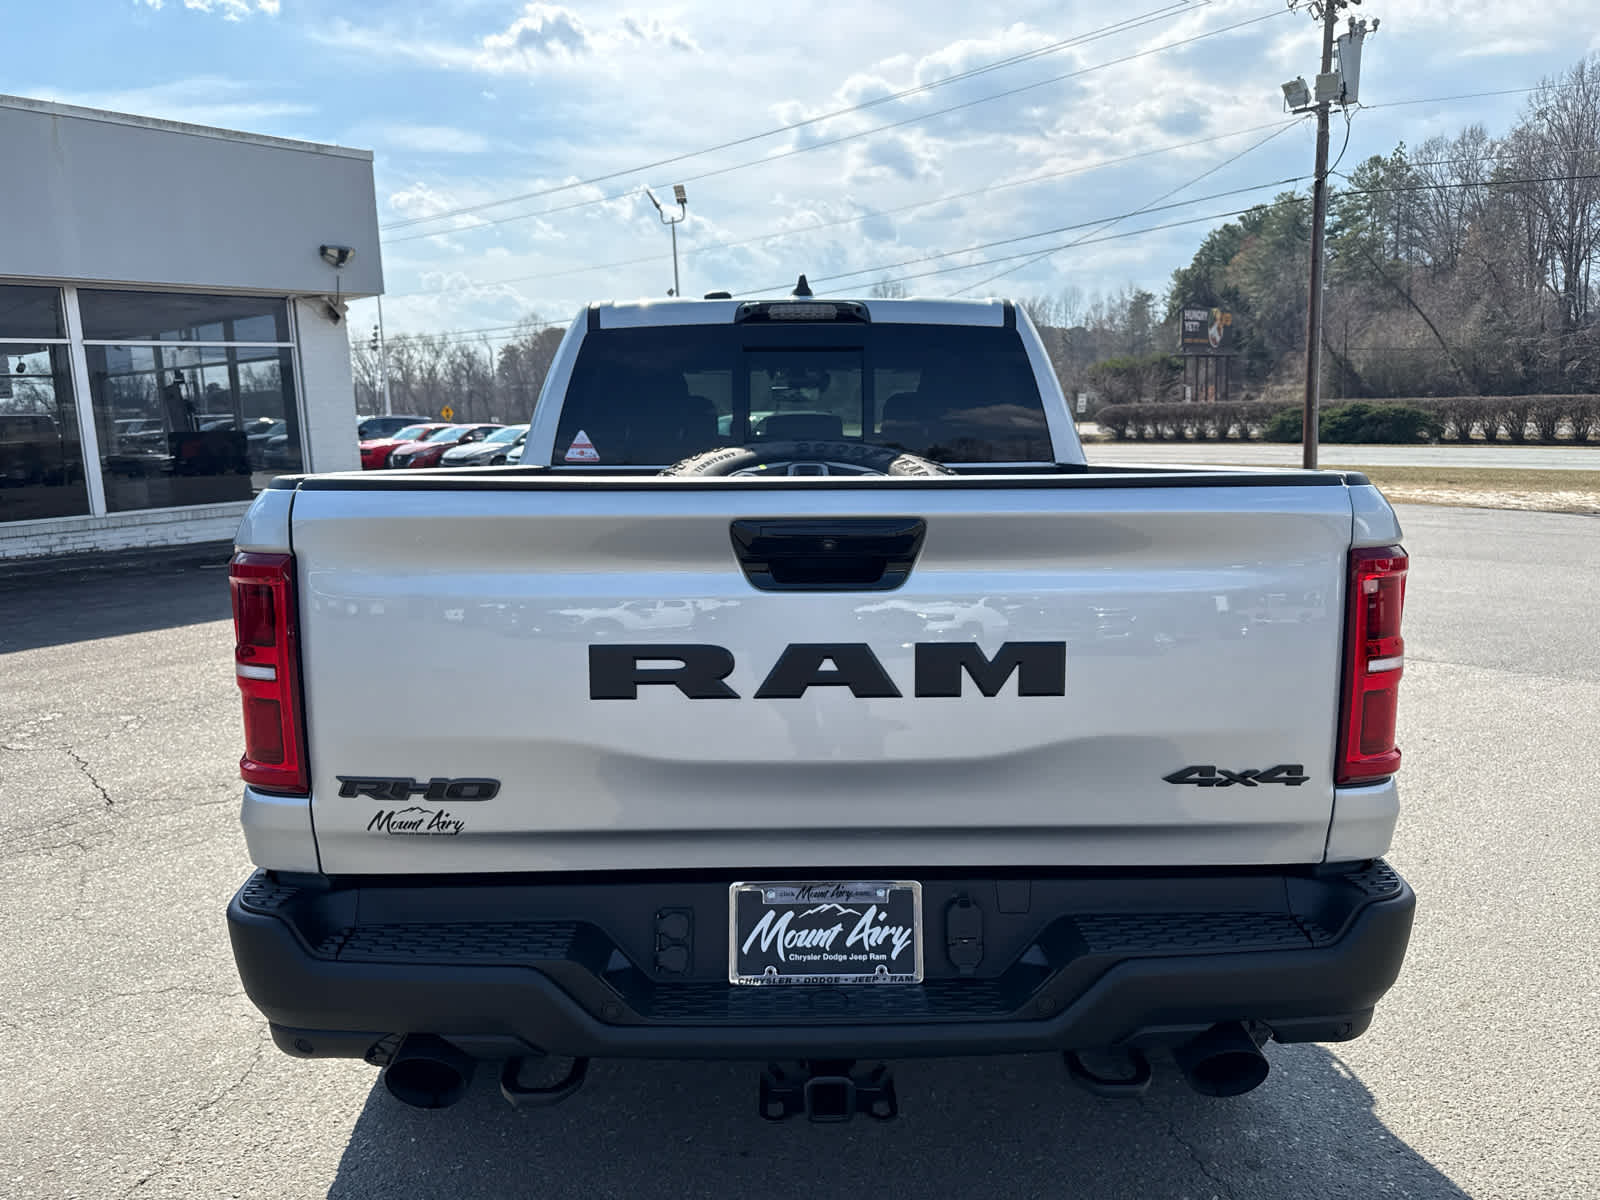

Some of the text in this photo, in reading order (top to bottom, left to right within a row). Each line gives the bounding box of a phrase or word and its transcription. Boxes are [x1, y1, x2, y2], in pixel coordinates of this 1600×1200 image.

[589, 641, 1066, 701] RAM
[336, 775, 502, 802] RHO
[1162, 764, 1310, 788] 4x4
[367, 809, 464, 836] Mount Airy
[742, 904, 912, 962] Mount Airy
[788, 952, 887, 962] Chrysler Dodge Jeep Ram
[737, 974, 914, 985] CHRYSLER DODGE JEEP RAM
